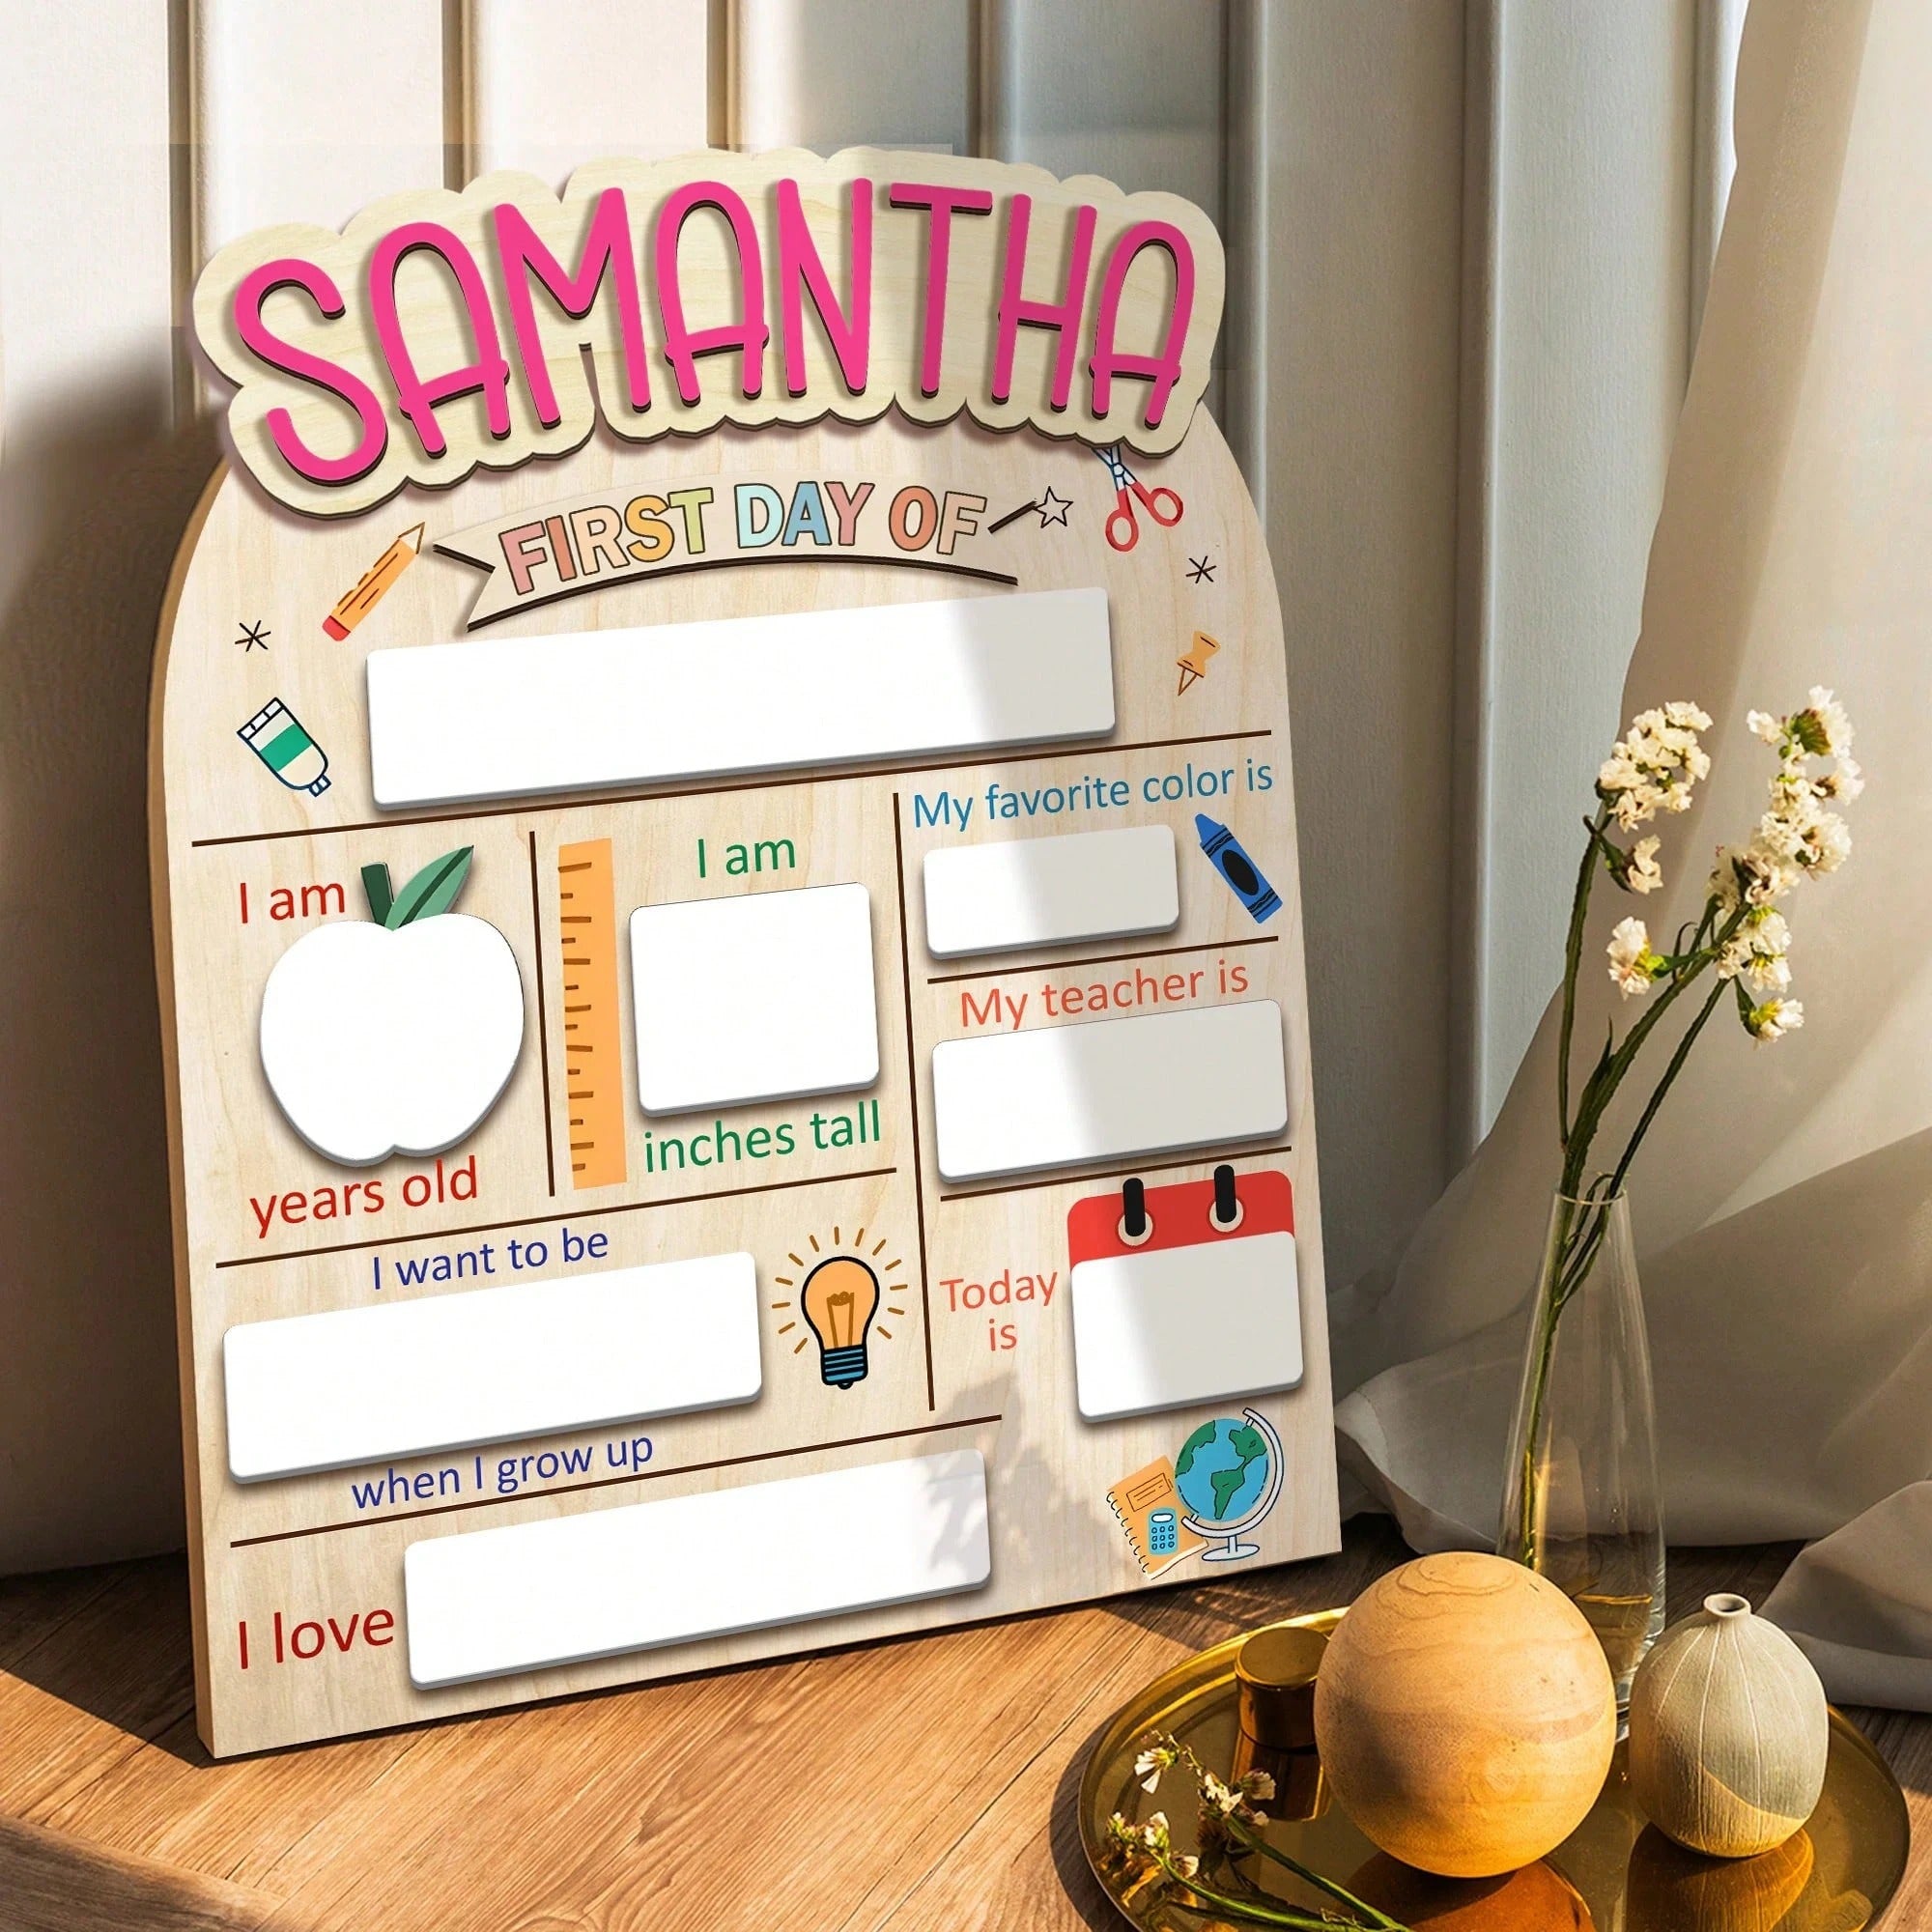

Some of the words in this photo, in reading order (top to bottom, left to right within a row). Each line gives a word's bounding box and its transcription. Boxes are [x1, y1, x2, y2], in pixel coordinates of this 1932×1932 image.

[234, 178, 1195, 486] SAMANTHA
[497, 486, 713, 596] FIRST
[734, 481, 875, 549] DAY
[888, 485, 986, 555] OF
[914, 791, 973, 833] My
[986, 777, 1130, 822] favorite
[1143, 764, 1235, 802] color
[1246, 758, 1273, 791] is
[696, 838, 706, 878] I
[724, 837, 796, 875] am
[239, 881, 250, 924] I
[269, 881, 346, 923] am
[959, 988, 1029, 1031] My
[1042, 968, 1206, 1017] teacher
[1217, 959, 1249, 994] is
[644, 1119, 795, 1173] inches
[810, 1099, 881, 1150] tall
[249, 1179, 384, 1239] years
[402, 1154, 478, 1208] old
[372, 1257, 381, 1291] I
[395, 1243, 496, 1286] want
[509, 1236, 548, 1268] to
[561, 1228, 609, 1263] be
[940, 1267, 1058, 1312] Today
[987, 1318, 1017, 1352] is
[351, 1466, 461, 1509] when
[474, 1456, 483, 1489] I
[497, 1446, 594, 1493] grow
[607, 1435, 654, 1475] up
[238, 1621, 250, 1670] I
[274, 1607, 395, 1663] love
